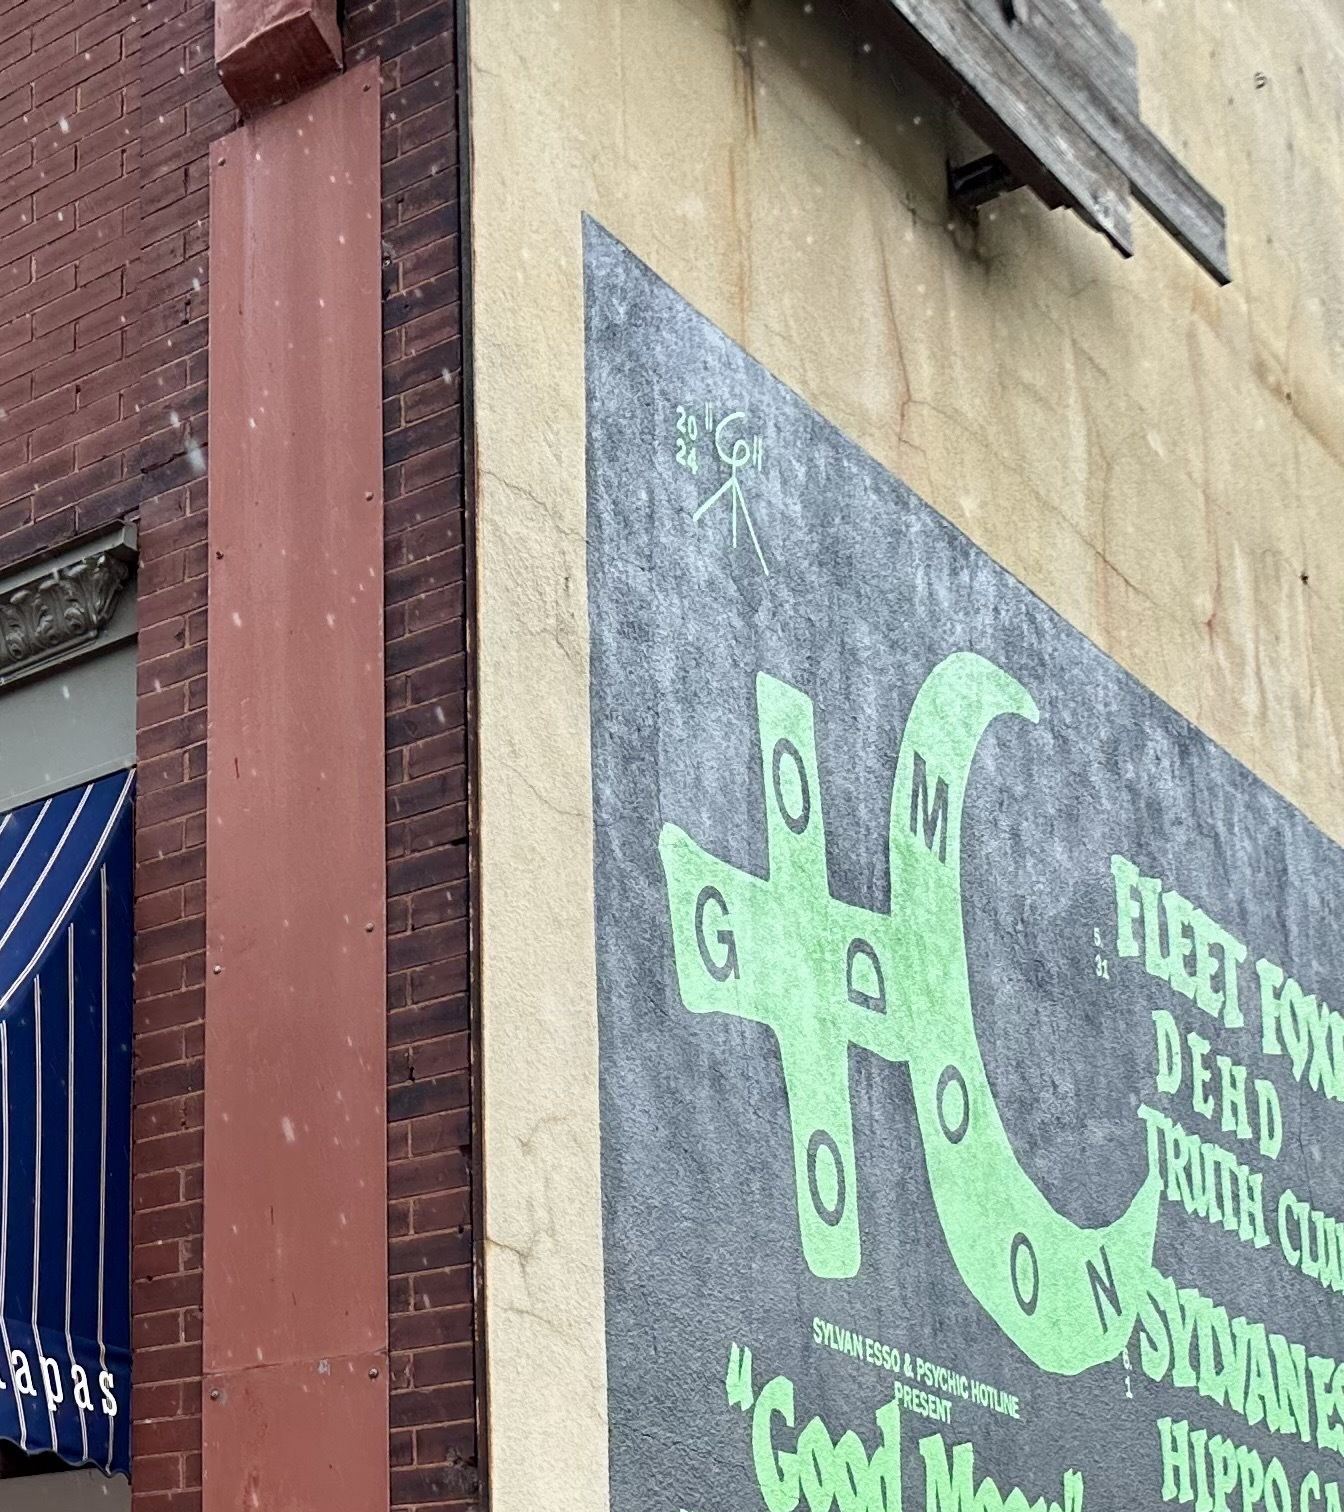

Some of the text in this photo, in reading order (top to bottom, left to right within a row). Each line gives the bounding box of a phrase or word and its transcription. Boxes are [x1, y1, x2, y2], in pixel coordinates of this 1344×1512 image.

[1110, 854, 1248, 1029] FLEET
[1151, 1009, 1283, 1160] DEHD
[1136, 1103, 1272, 1249] TRUTH
[812, 1316, 1021, 1420] SYLVAN ESSO & PSYCHIC HOTLINE
[893, 1380, 953, 1425] PRESENT
[1138, 1266, 1312, 1443] SYLVAN
